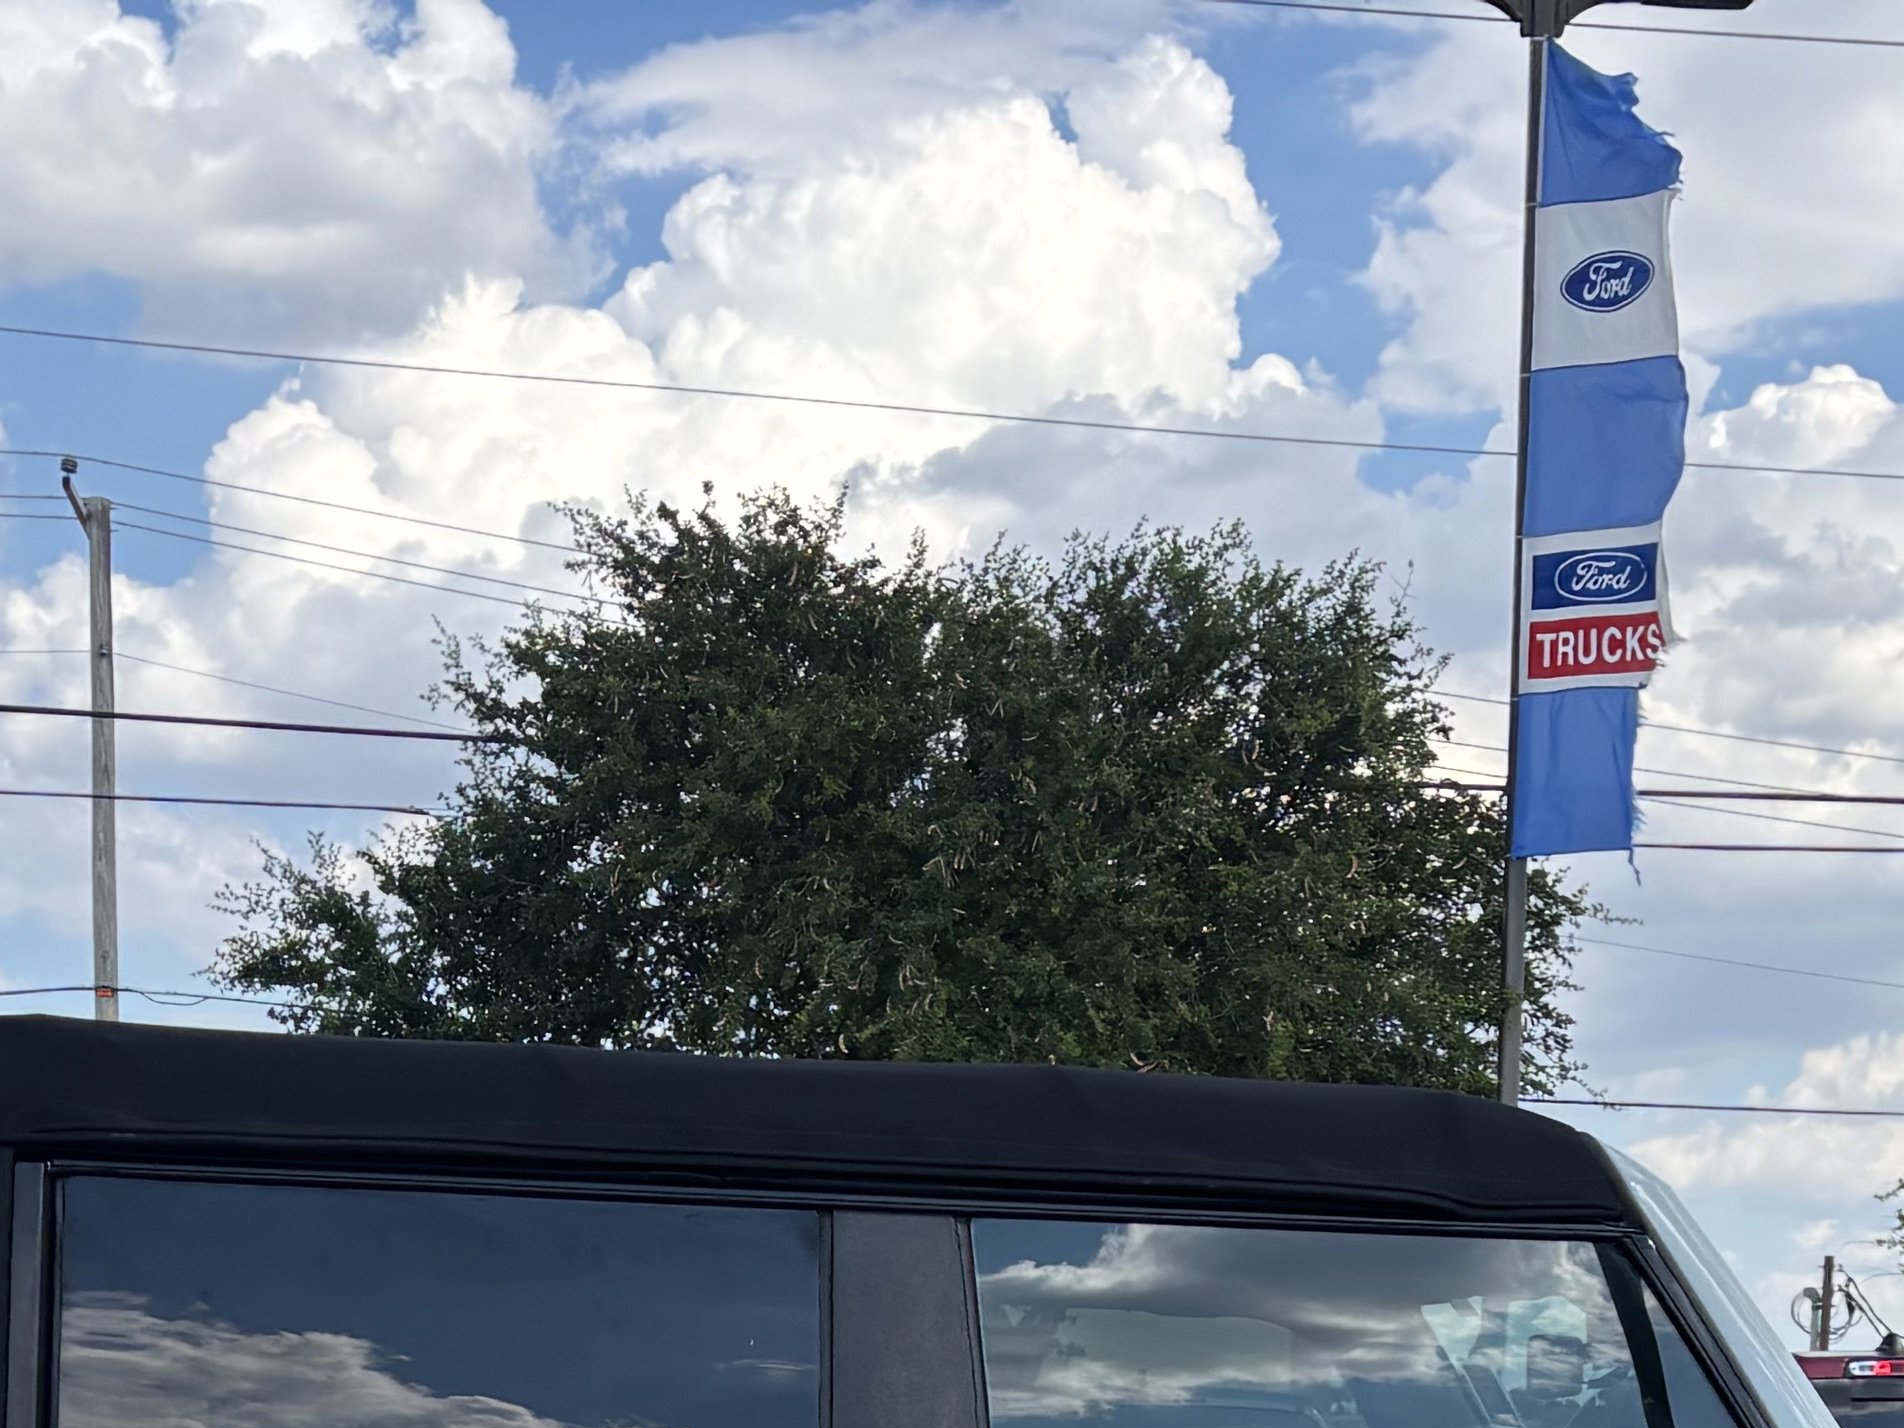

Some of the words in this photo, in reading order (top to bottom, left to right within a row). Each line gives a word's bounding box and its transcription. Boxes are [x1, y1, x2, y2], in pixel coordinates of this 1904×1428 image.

[1582, 260, 1635, 301] Ford
[1571, 560, 1631, 591] Ford
[1535, 623, 1664, 668] TRUCKS
